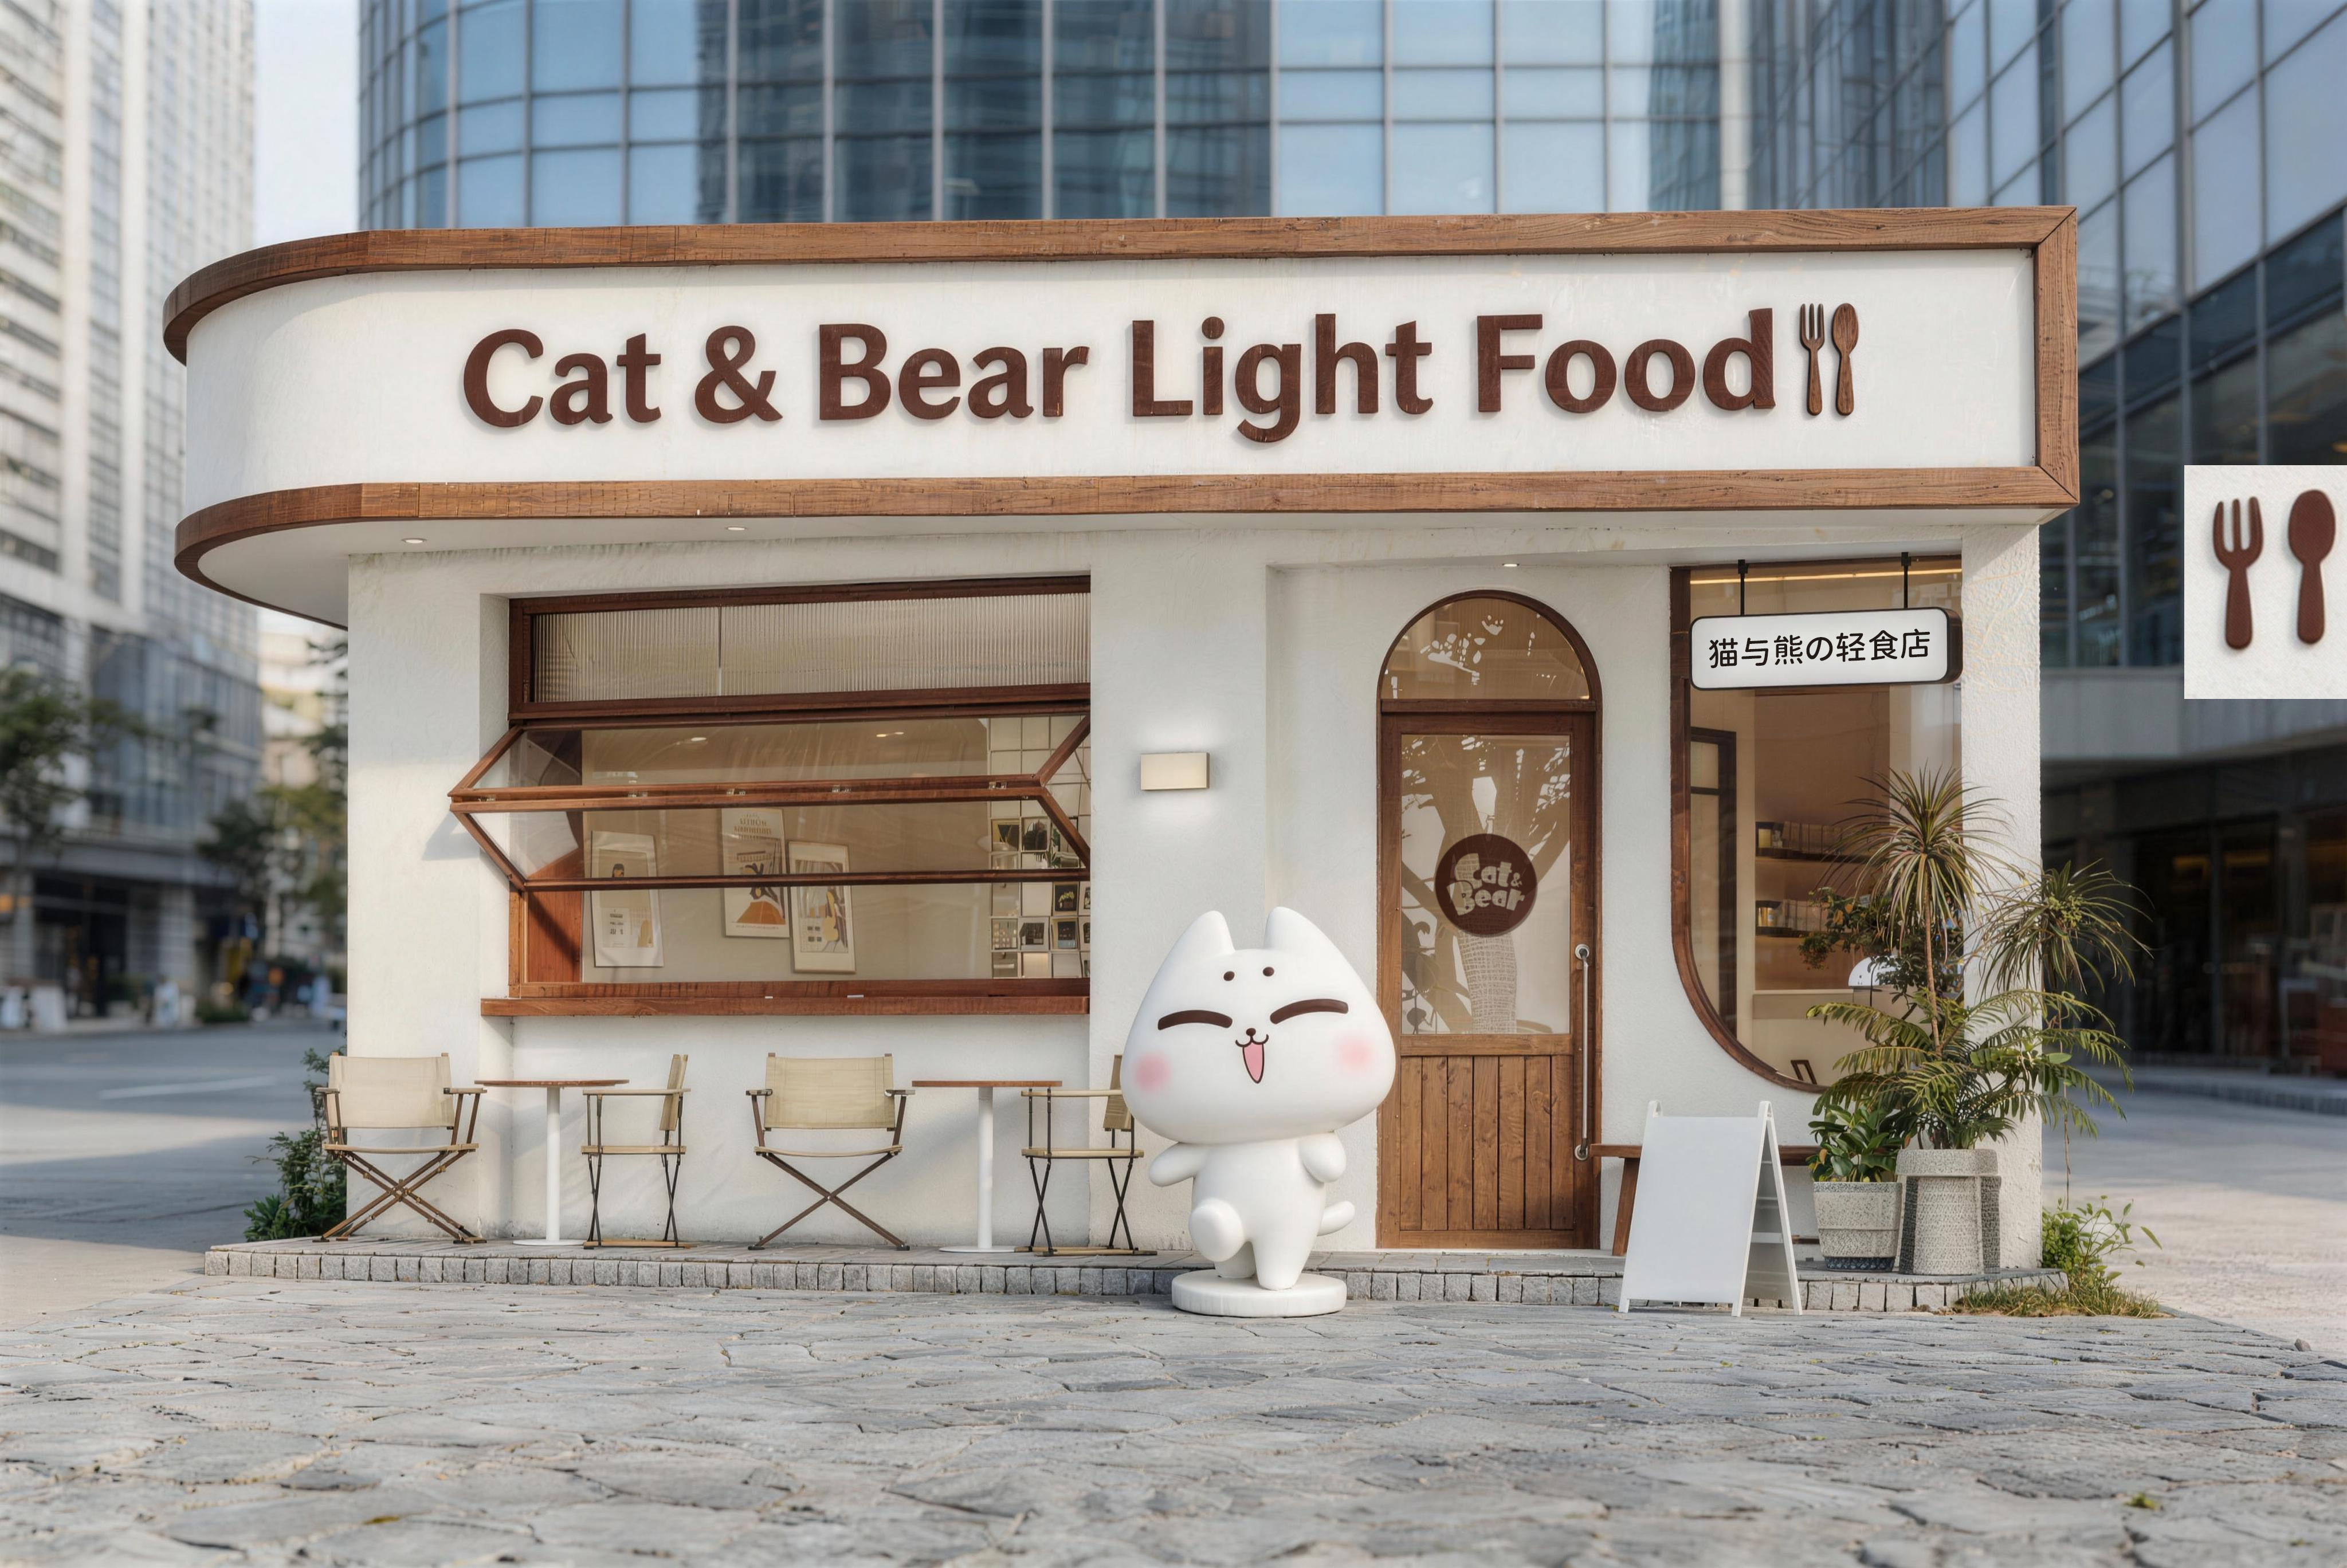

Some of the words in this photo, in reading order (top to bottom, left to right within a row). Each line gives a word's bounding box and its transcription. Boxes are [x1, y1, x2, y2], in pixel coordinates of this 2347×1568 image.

[463, 329, 661, 428] Cat
[694, 325, 783, 424] &
[819, 323, 1090, 421] Bear
[1132, 313, 1434, 443] Light
[1477, 308, 1776, 414] Food
[1708, 628, 1930, 669] 猫与熊の轻食店
[1455, 853, 1512, 889] Cat
[1510, 873, 1522, 887] &
[1446, 881, 1525, 915] Bear
